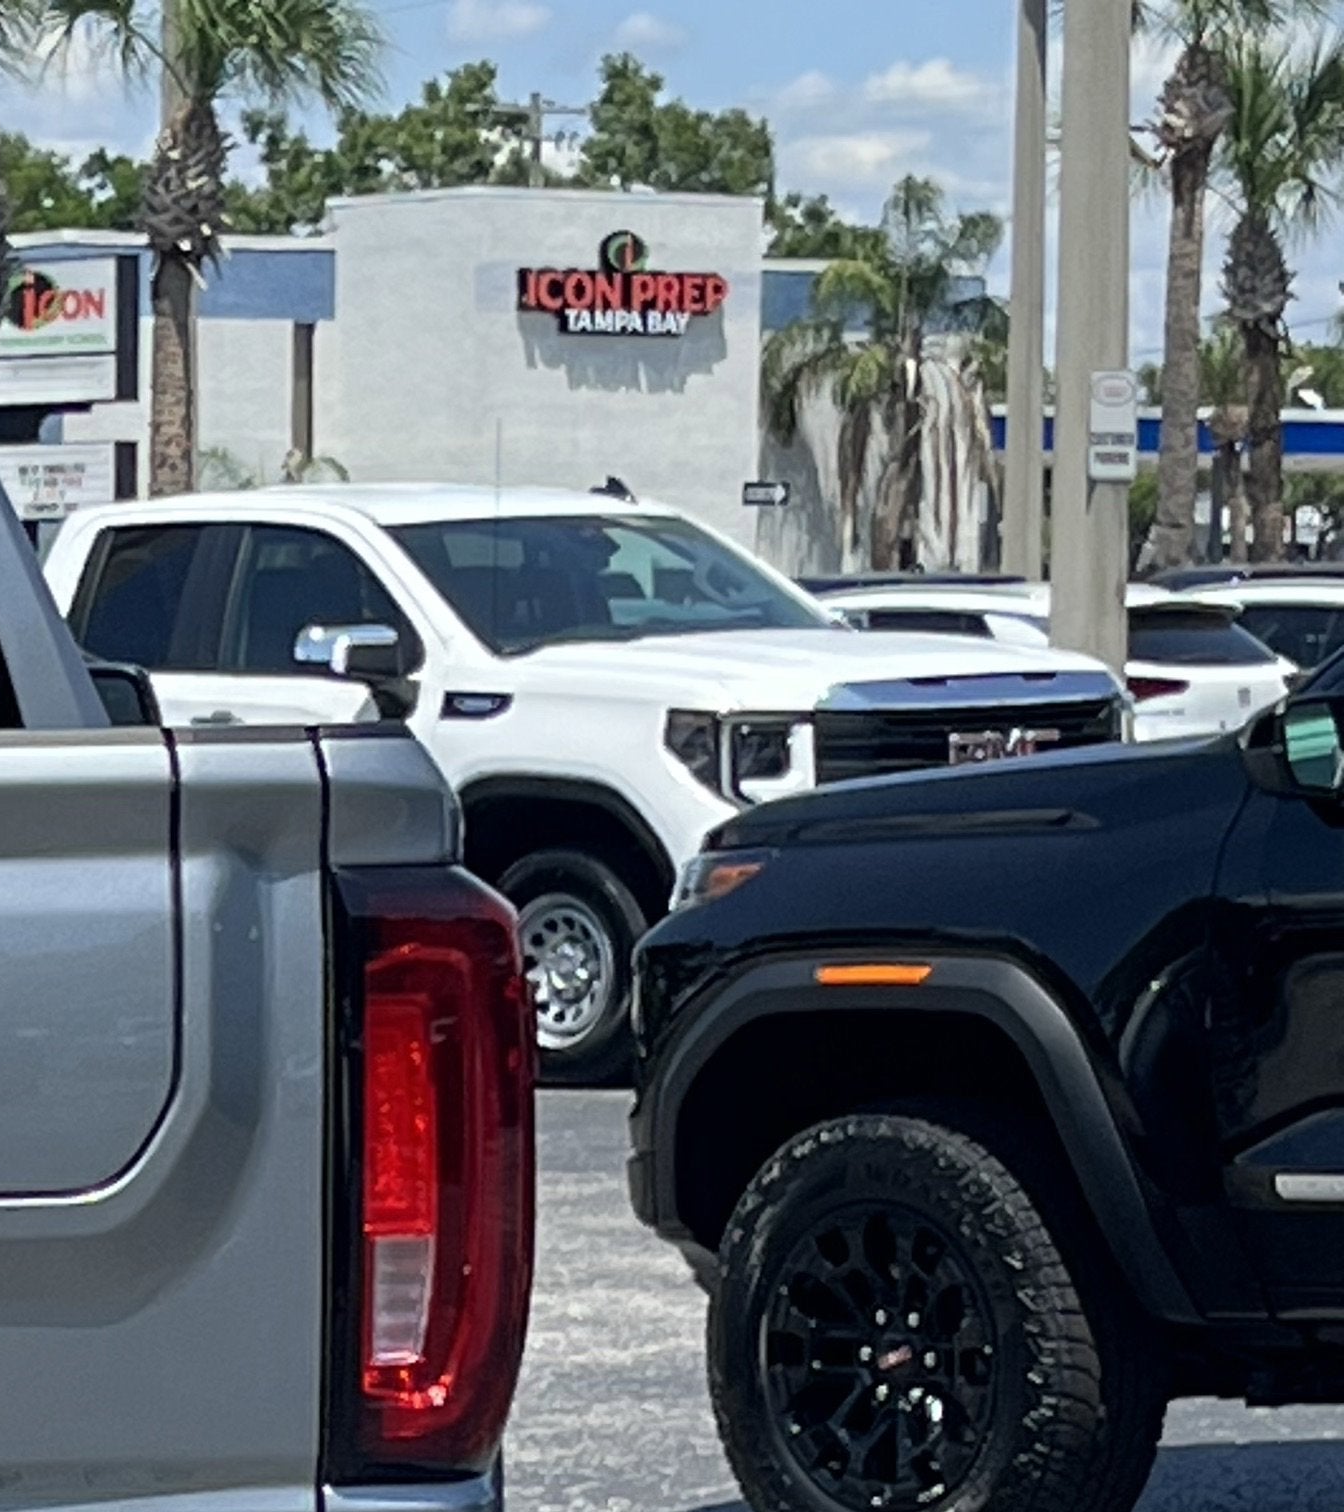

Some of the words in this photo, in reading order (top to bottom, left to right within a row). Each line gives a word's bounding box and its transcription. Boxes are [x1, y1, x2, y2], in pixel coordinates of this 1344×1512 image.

[522, 270, 622, 310] ICON
[631, 273, 729, 314] PREP
[565, 309, 643, 332] TAMPA
[648, 312, 690, 334] BAY
